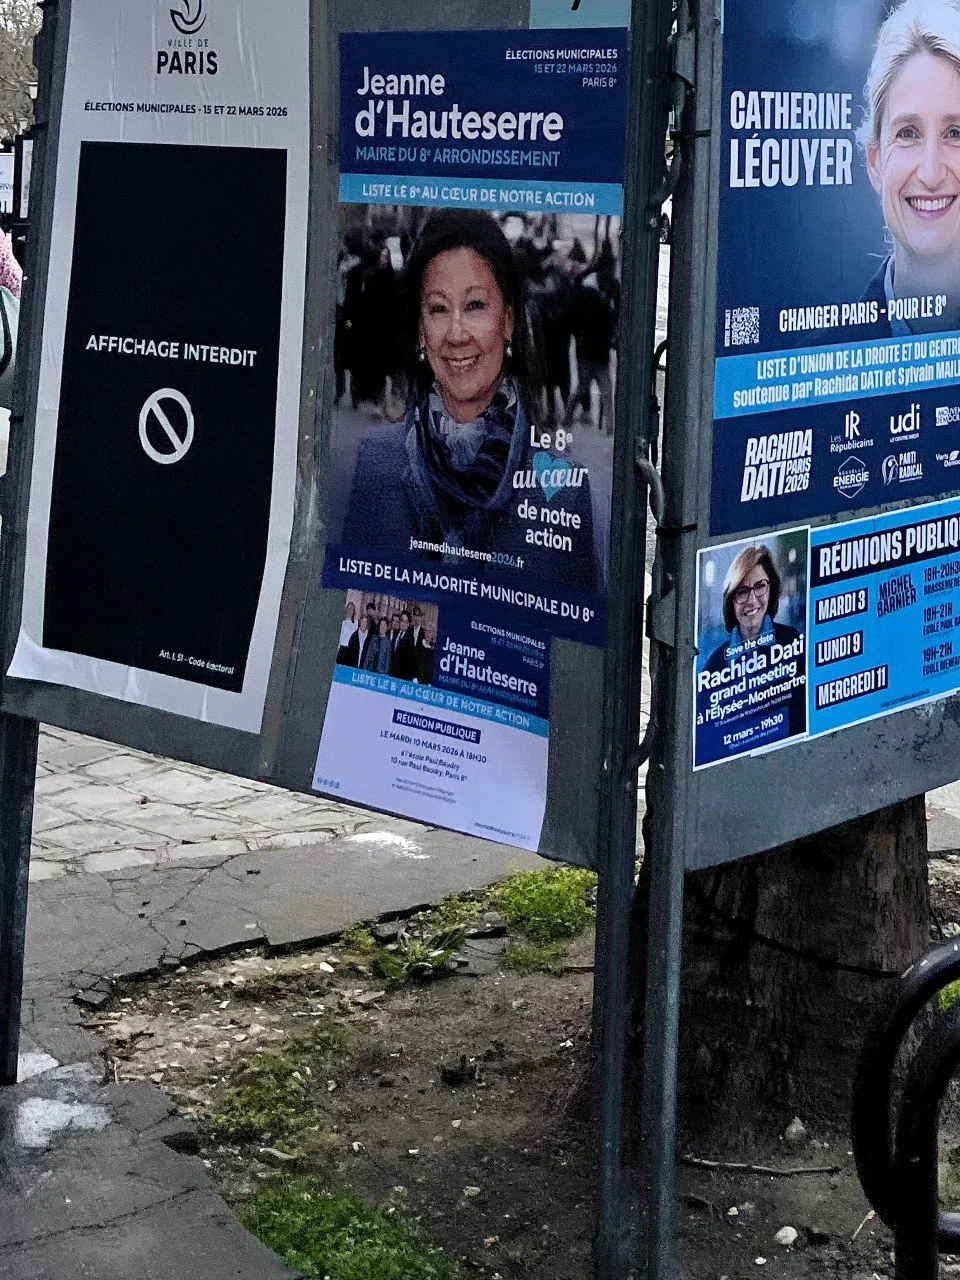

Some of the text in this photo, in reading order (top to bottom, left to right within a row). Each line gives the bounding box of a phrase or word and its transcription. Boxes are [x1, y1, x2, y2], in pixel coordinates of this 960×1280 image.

[156, 50, 218, 75] PARIS
[505, 48, 618, 60] ÉLECTIONS MUNICIPALES
[356, 66, 445, 96] Jeanne
[582, 77, 607, 88] PARIS
[84, 100, 288, 117] ÉLECTIONS MUNICIPALES MARS 2026
[355, 100, 564, 142] d'Hauteserre
[730, 90, 853, 130] CATHERINE
[433, 148, 561, 167] ARRONDISSEMENT
[729, 132, 853, 188] LÉCUYER
[362, 184, 595, 207] LISTE LE AU DE NOTRE ACTION
[779, 295, 933, 333] CHANGER PARIS POUR LE
[85, 334, 258, 367] AFFICHAGE INTERDIT
[756, 359, 787, 380] LISTE
[789, 354, 835, 376] D'UNION
[835, 353, 849, 370] DE
[850, 351, 863, 368] LA
[865, 345, 900, 366] DROITE
[901, 343, 914, 361] ET
[914, 341, 928, 359] DU
[733, 385, 789, 408] soutenue
[791, 382, 813, 403] par
[814, 376, 859, 397] Rachida
[860, 371, 883, 391] DATI
[885, 370, 897, 386] et
[898, 364, 934, 387] Sylvain
[890, 403, 920, 434] udi
[530, 425, 551, 449] Le
[745, 428, 813, 467] RACHIDA
[830, 437, 874, 453] Républicains
[786, 456, 812, 476] PARIS
[898, 463, 923, 480] RADICAL
[899, 451, 917, 465] PARTI
[513, 469, 537, 489] au
[740, 460, 787, 503] DATI
[784, 472, 810, 494] 2026
[517, 499, 581, 529] de notre
[409, 536, 525, 569] jeannedhauteserre2026.fr
[526, 527, 573, 552] action
[819, 530, 902, 578] RÉUNIONS
[339, 557, 580, 620] LISTE DE LA MAJORITÉ MUNICIPALE DU
[878, 572, 914, 601] MICHEL
[923, 580, 953, 596] BRASSERIE
[818, 589, 866, 622] MARDI 3
[876, 587, 917, 618] BARNIER
[442, 637, 486, 661] Jeanne
[725, 633, 774, 657] Save the date
[818, 632, 861, 664] LUNDI 9
[439, 654, 538, 697] d'Hauteserre
[697, 633, 804, 693] Rachida Dati
[709, 660, 798, 708] grand meeting
[818, 669, 875, 707] MERCREDI
[876, 666, 886, 687] 11
[435, 723, 477, 741] PUBLIQUE
[696, 712, 704, 726] à
[723, 713, 784, 745] 12 mars 19h30
